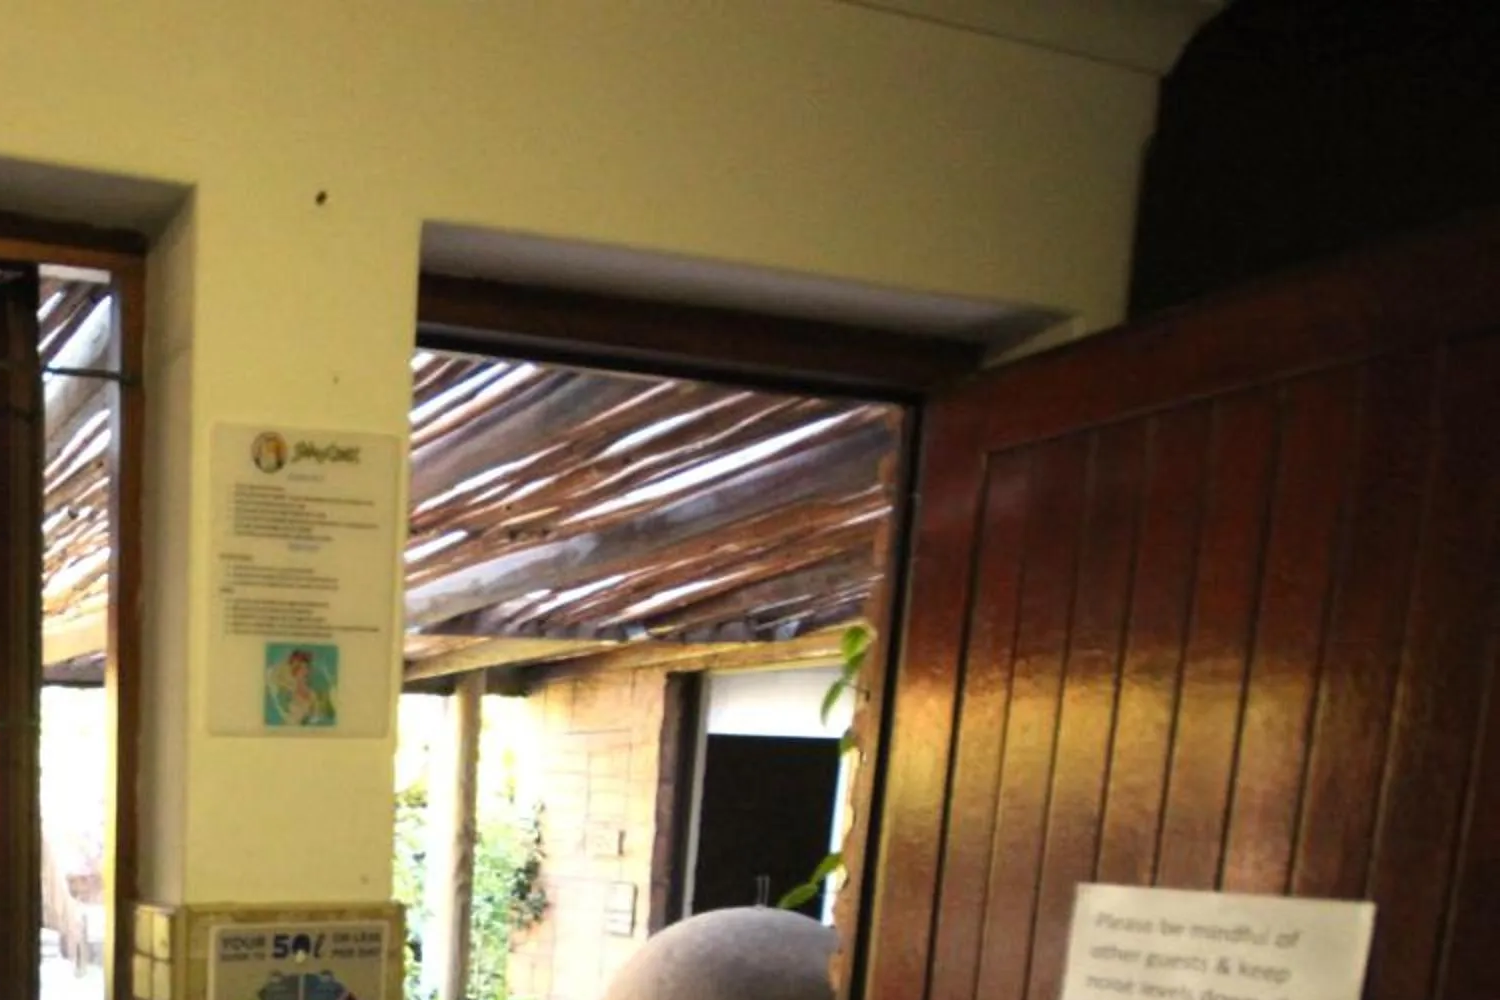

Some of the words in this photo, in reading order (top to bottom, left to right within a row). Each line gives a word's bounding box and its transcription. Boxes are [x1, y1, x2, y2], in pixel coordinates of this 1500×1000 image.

[1094, 911, 1153, 934] Please
[1159, 917, 1185, 936] be
[1189, 923, 1269, 946] mindful
[1274, 928, 1303, 950] of
[1088, 944, 1141, 962] other
[1144, 951, 1207, 974] guests
[1216, 956, 1230, 975] &
[1238, 960, 1293, 985] keep
[1084, 974, 1134, 996] noise
